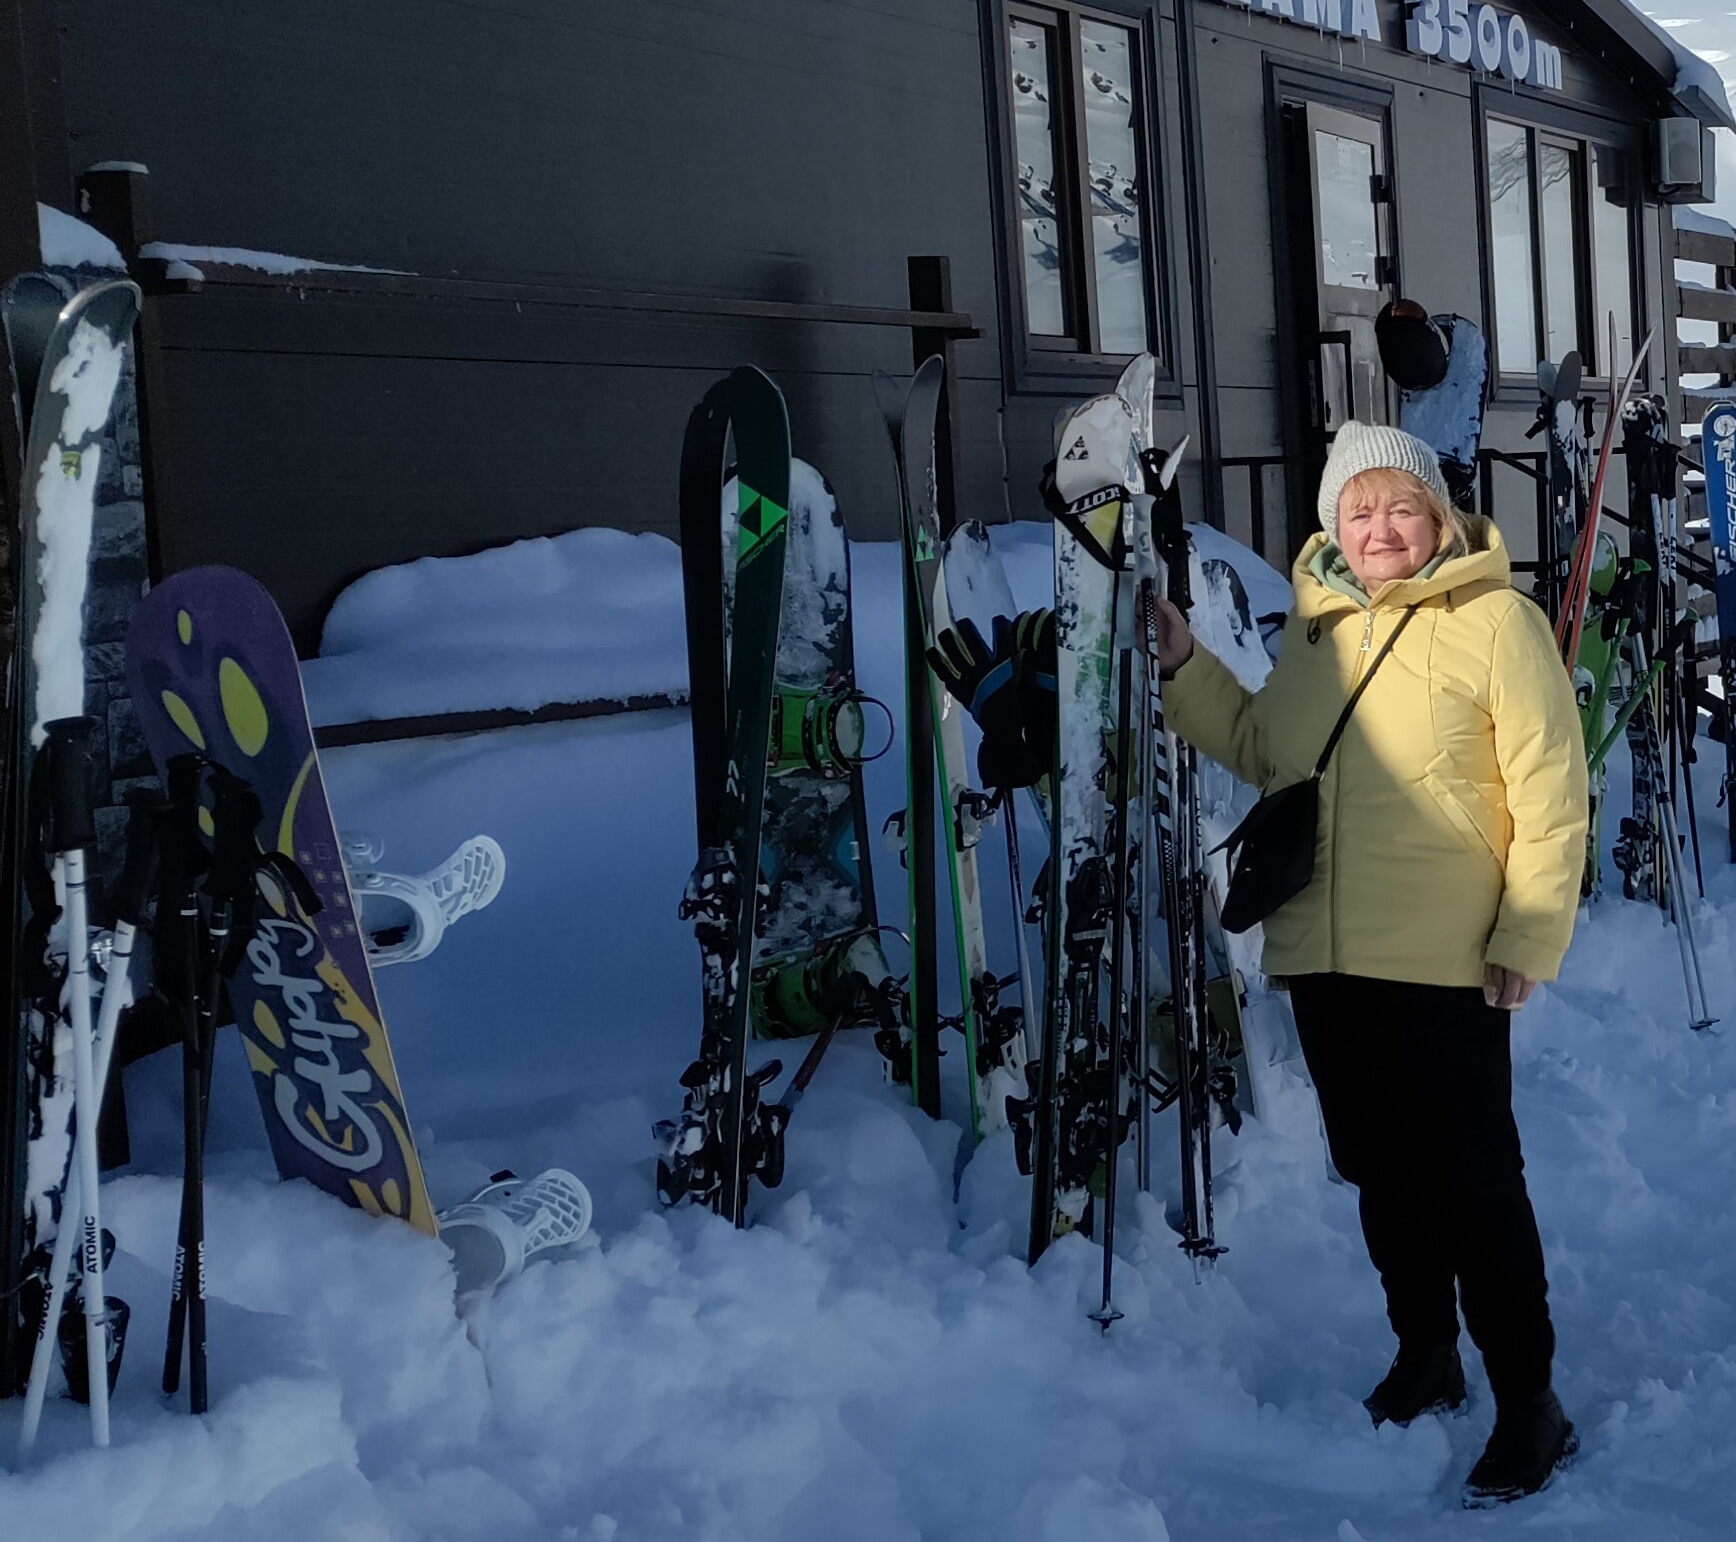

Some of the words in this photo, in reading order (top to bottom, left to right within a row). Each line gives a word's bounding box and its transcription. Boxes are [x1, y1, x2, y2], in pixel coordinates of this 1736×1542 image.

[1064, 486, 1121, 515] SCOTT
[246, 919, 383, 1172] Guppy
[84, 1215, 98, 1274] ATOMIC
[172, 1244, 186, 1302] ATOMIC
[37, 1282, 54, 1341] ATOMIC
